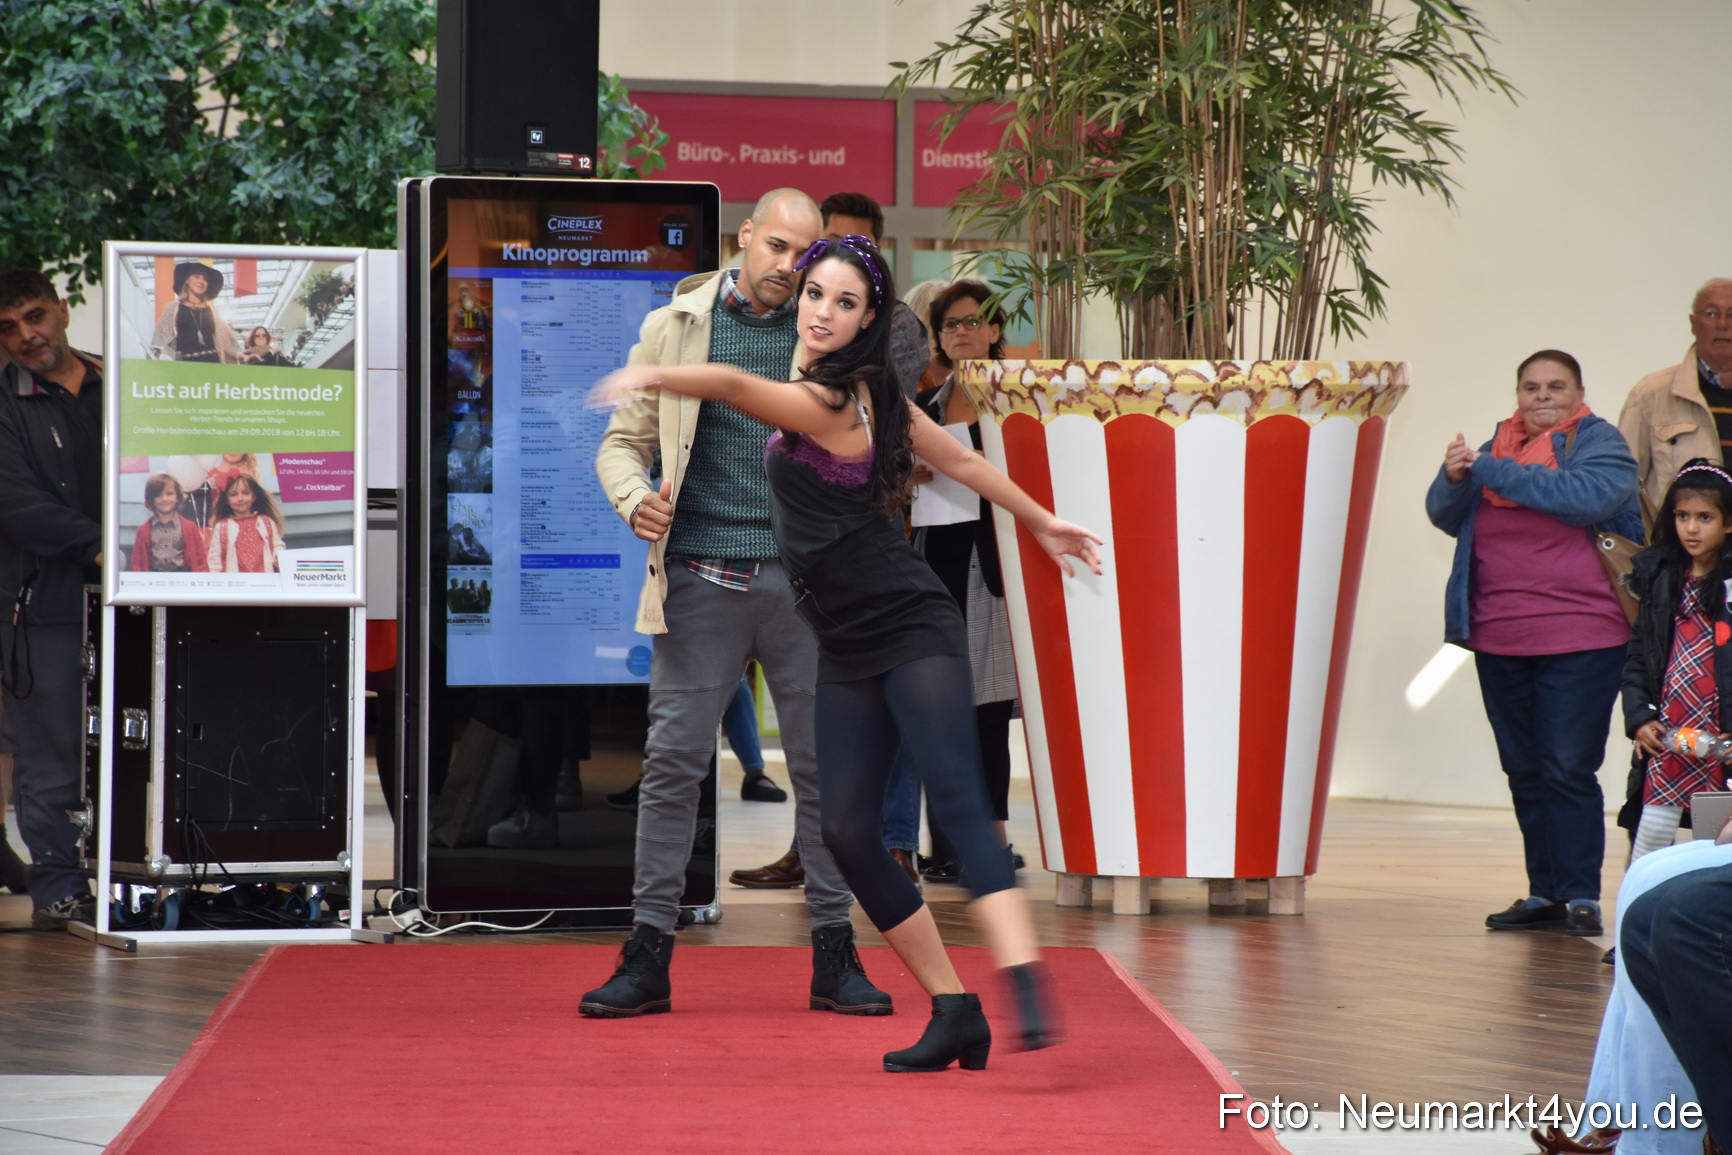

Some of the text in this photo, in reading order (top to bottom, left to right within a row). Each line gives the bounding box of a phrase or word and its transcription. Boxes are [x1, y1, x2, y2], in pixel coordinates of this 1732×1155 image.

[677, 142, 846, 166] Büro-, Praxis- und
[578, 157, 590, 169] 12
[547, 217, 603, 231] CINEPLEX
[502, 243, 649, 266] Kinoprogramm
[132, 382, 343, 401] Lust auf Herbstmode?
[457, 390, 481, 399] BALLON
[293, 573, 346, 581] NeuerMarkt
